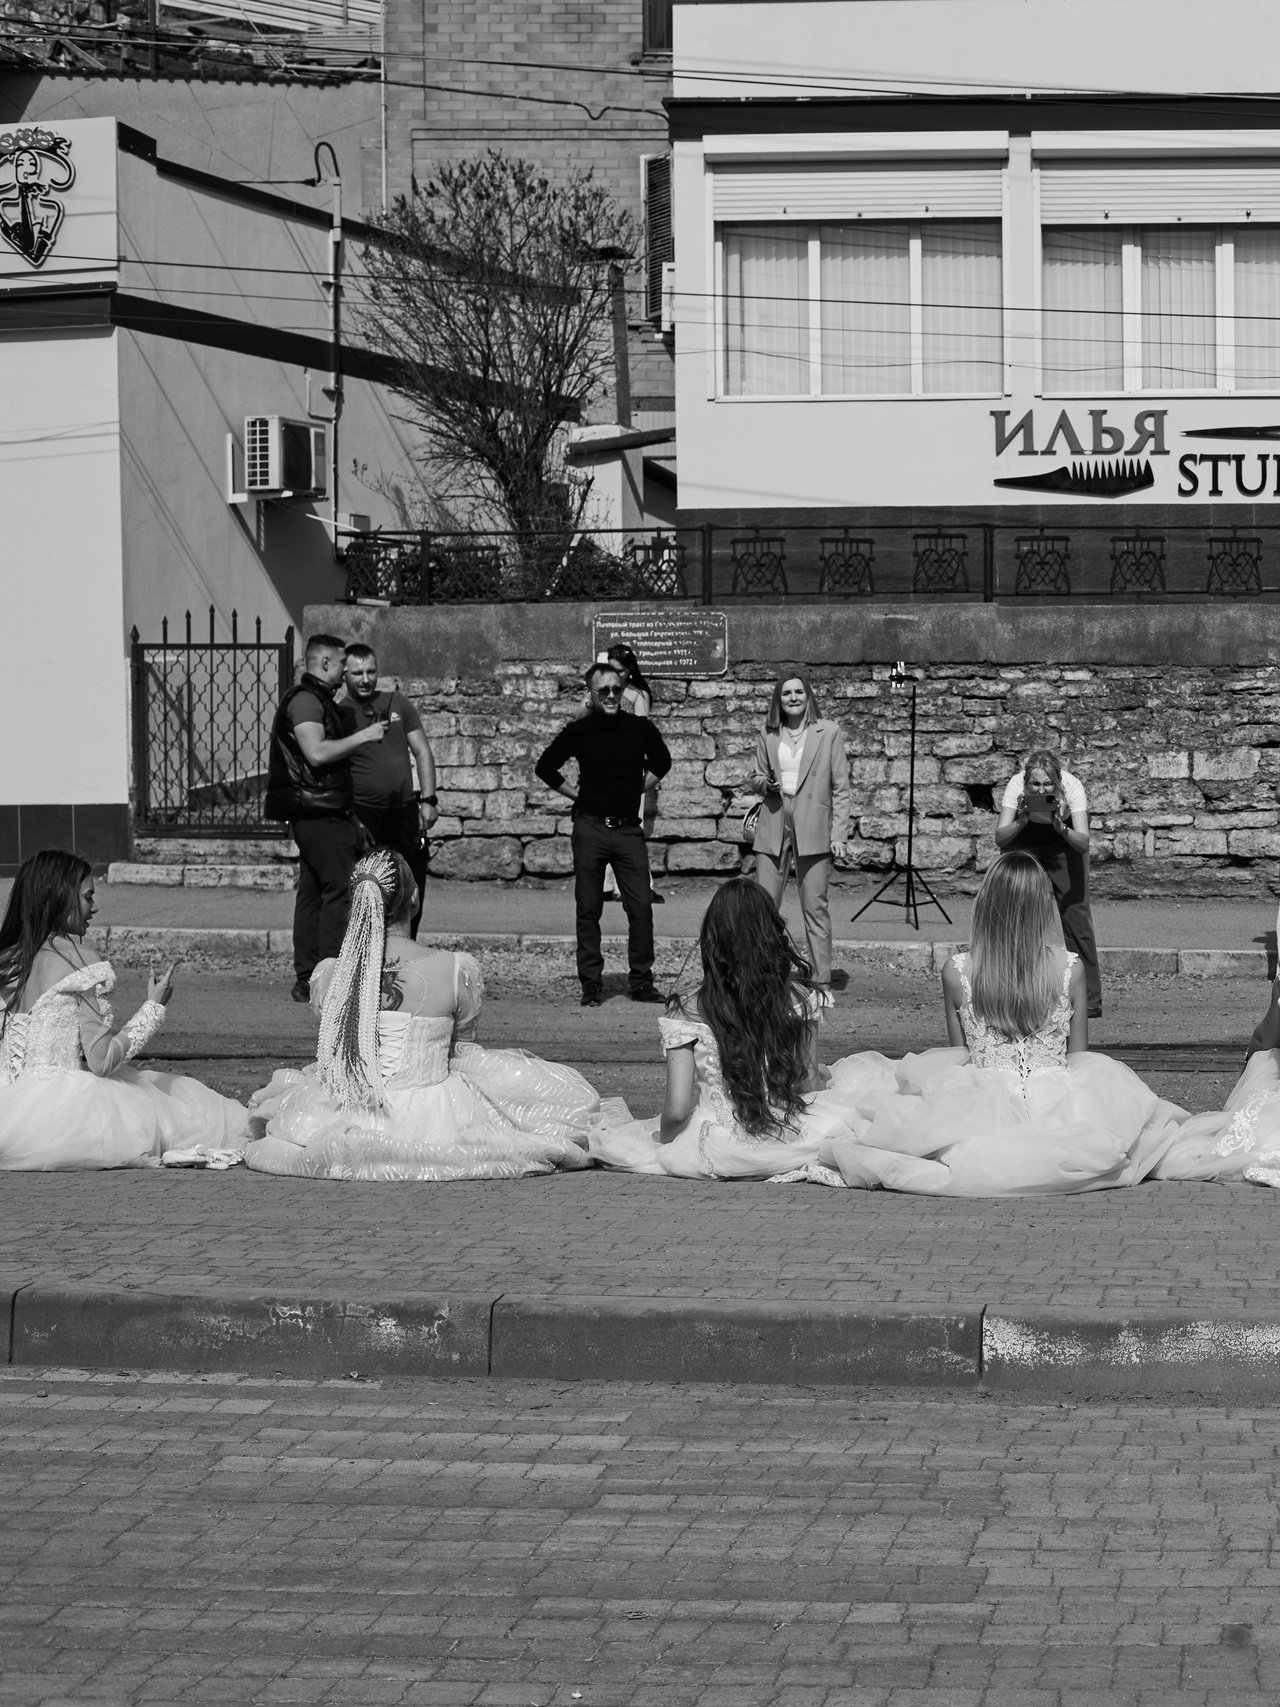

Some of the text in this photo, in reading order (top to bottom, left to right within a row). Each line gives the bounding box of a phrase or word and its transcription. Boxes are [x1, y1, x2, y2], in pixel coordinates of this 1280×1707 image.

[989, 408, 1171, 457] ИЛЬЯ
[610, 631, 620, 639] ул.
[636, 659, 673, 667] еплосерная
